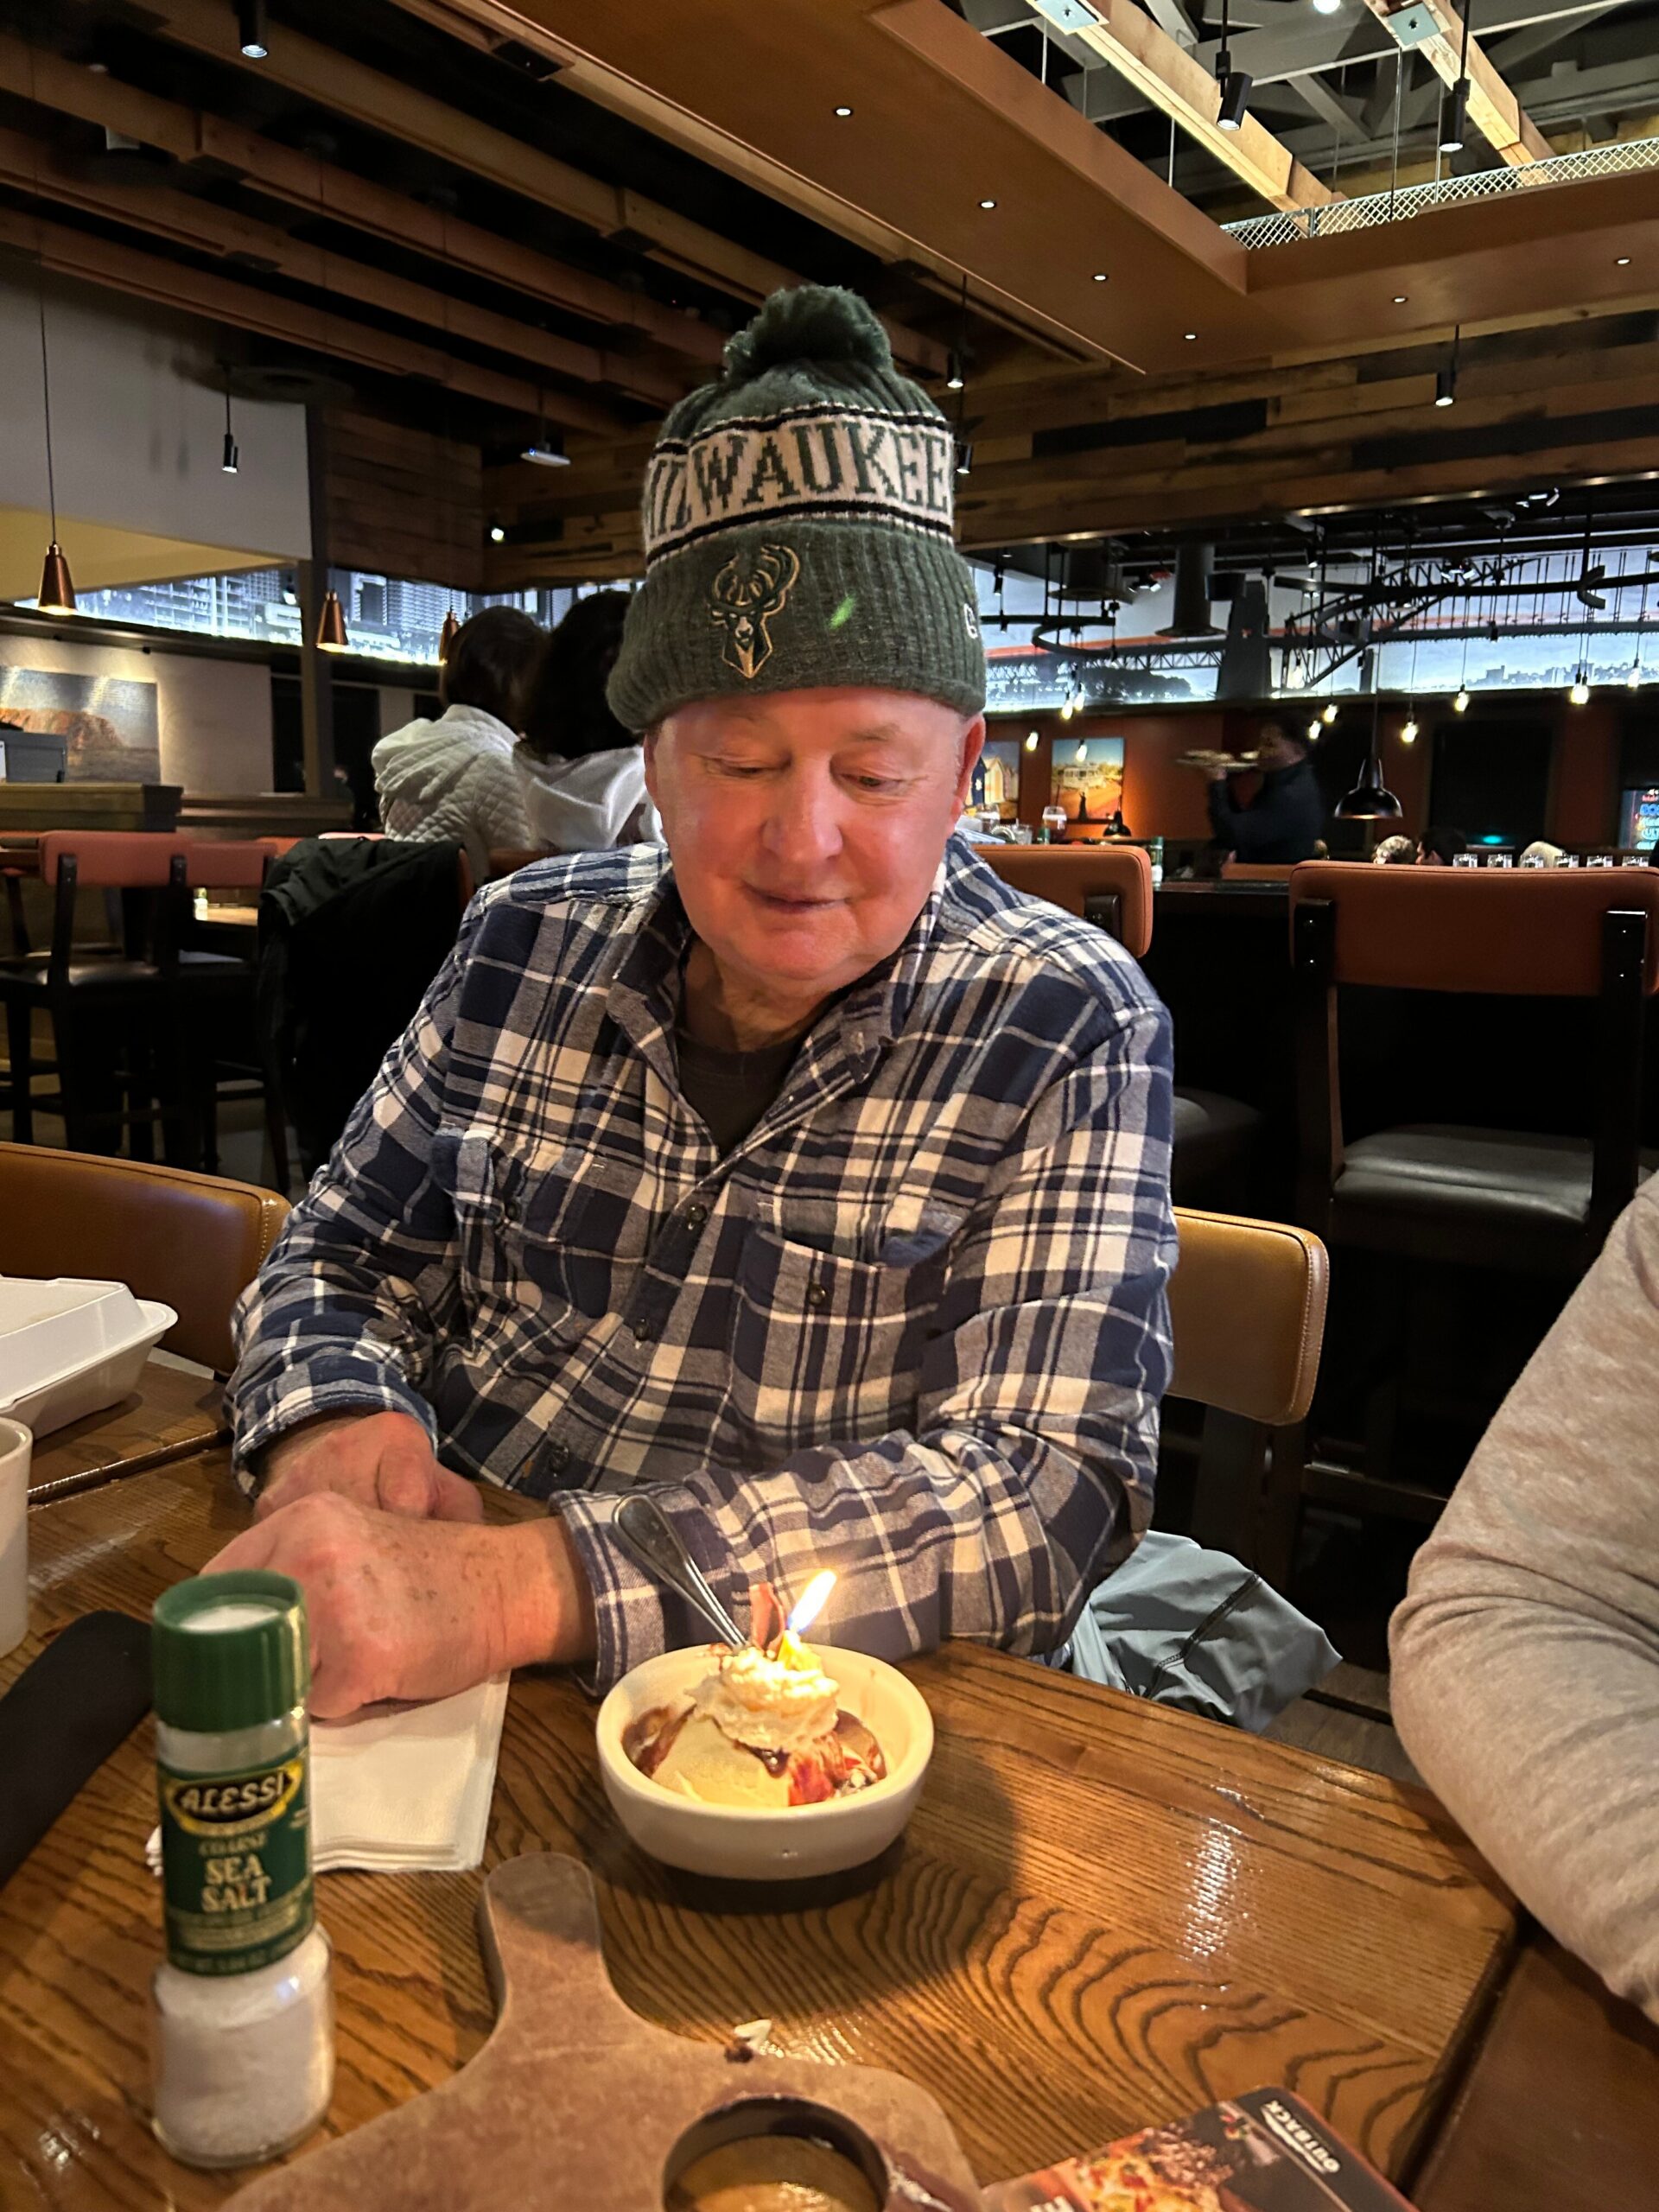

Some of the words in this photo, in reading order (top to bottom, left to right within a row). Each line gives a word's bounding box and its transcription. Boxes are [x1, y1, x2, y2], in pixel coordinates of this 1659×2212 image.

[180, 1771, 283, 1814] ALESSI
[204, 1853, 265, 1885] SEA
[201, 1875, 272, 1912] SALT
[1263, 2100, 1340, 2173] OUTBACK
